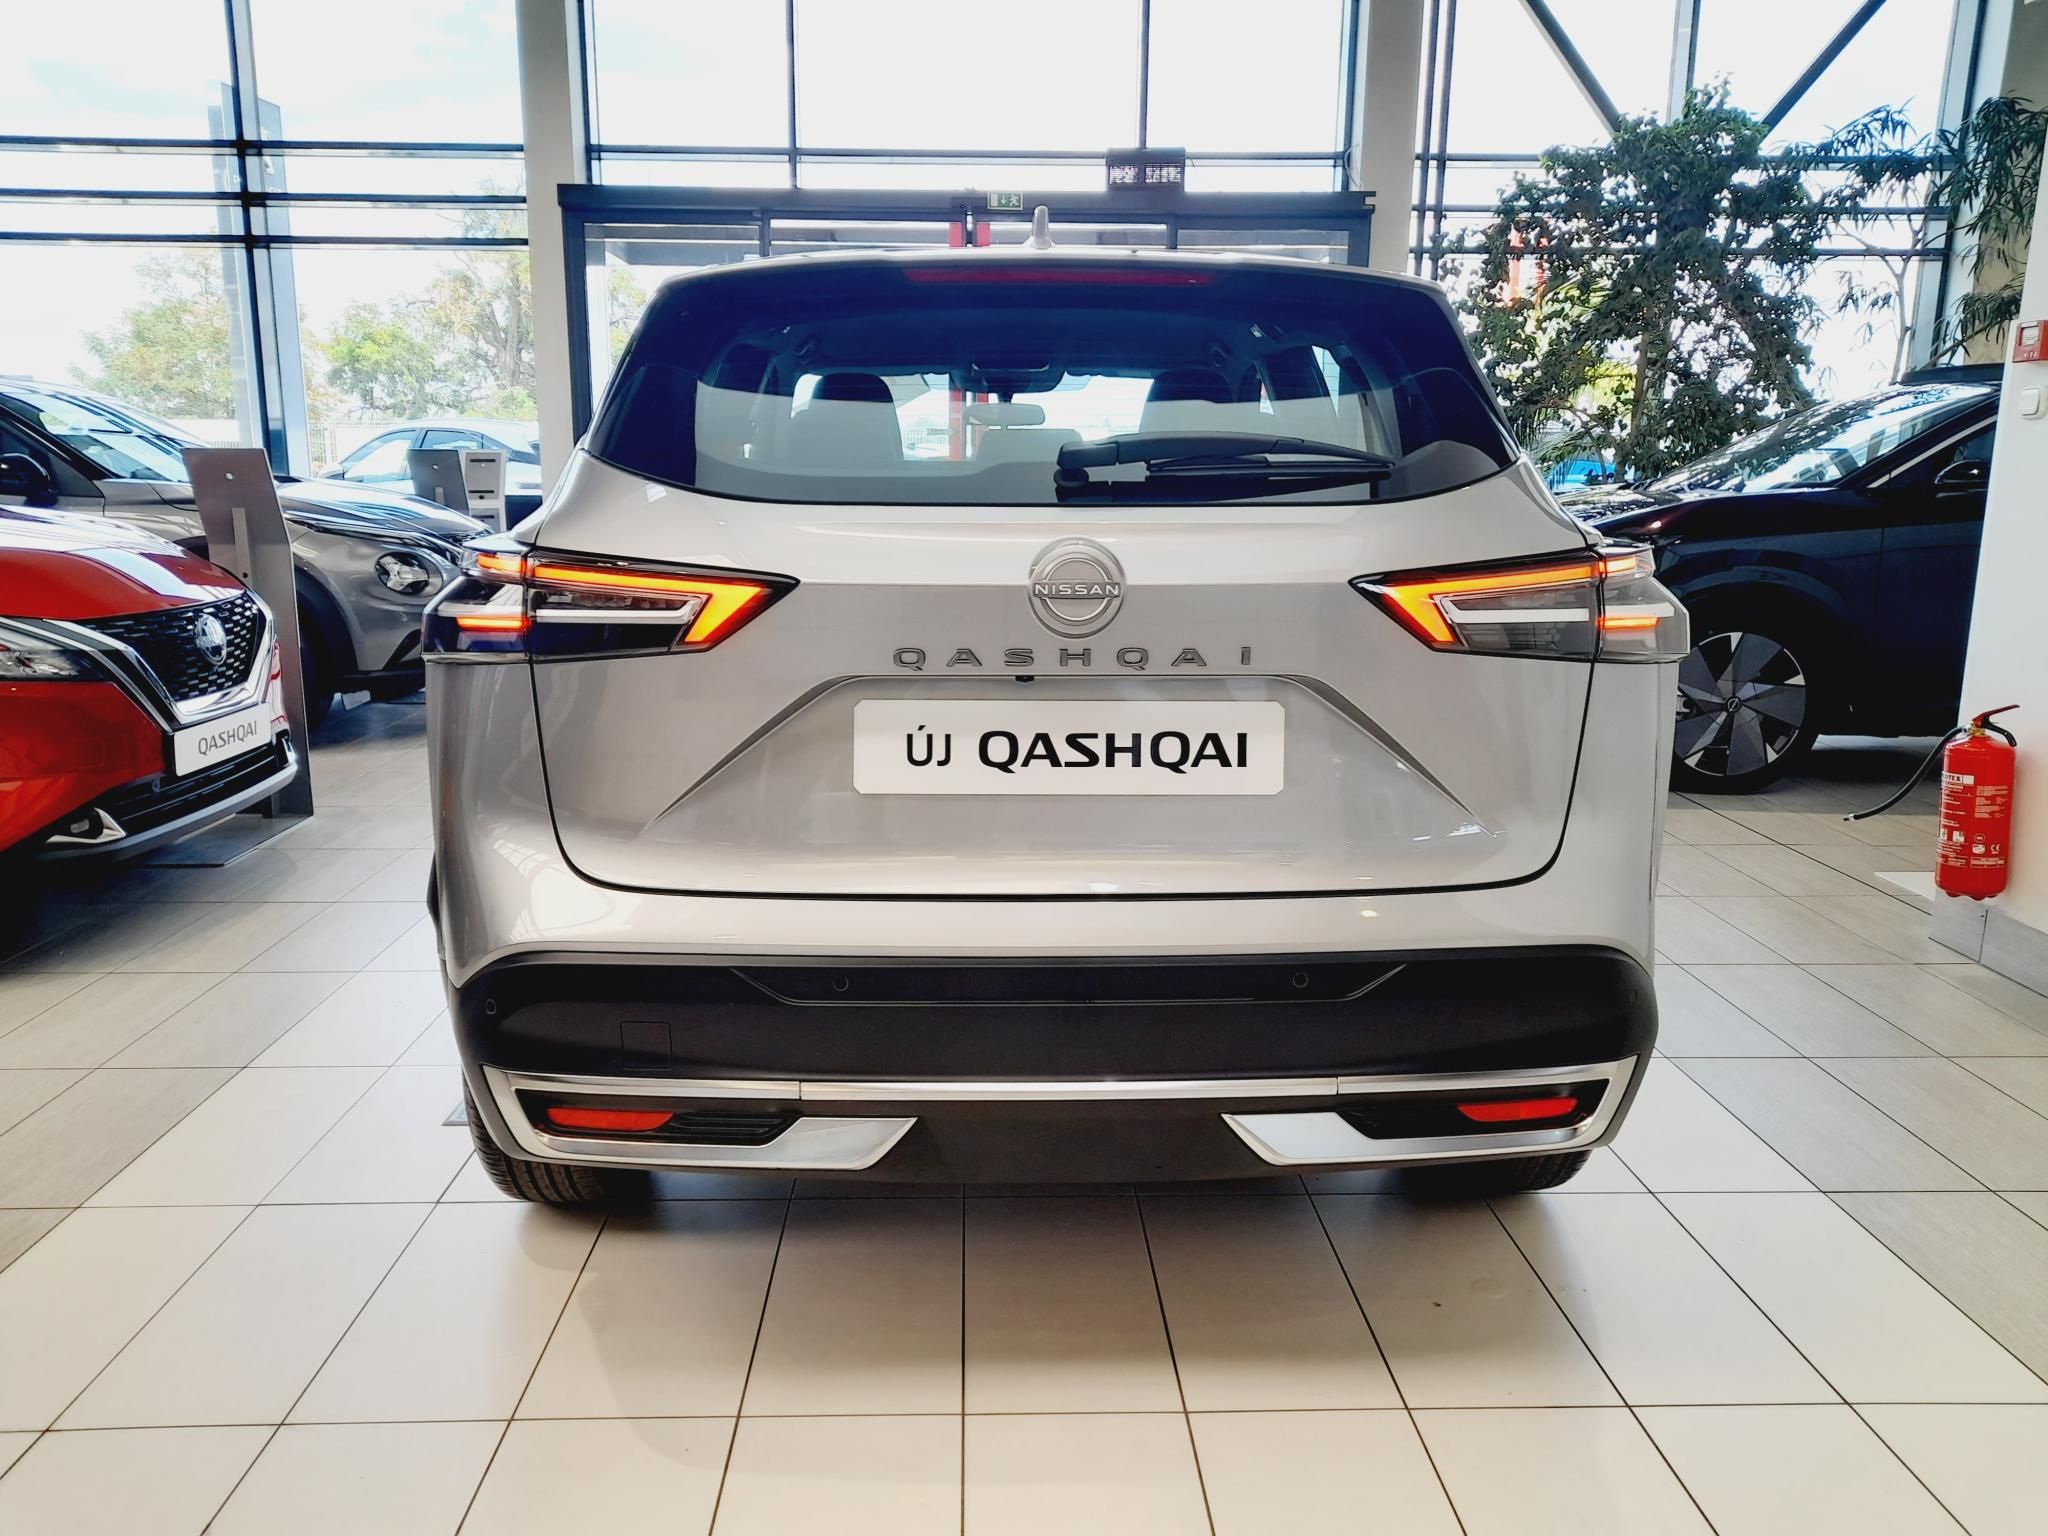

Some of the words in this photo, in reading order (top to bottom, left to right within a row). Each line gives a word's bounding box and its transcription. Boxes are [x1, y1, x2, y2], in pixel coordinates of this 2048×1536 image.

[1034, 583, 1120, 597] NISSAN
[893, 646, 1252, 671] QASHQAI
[198, 720, 257, 756] QASHQAI
[906, 725, 952, 767] ÚJ
[978, 730, 1248, 774] QASHQAI
